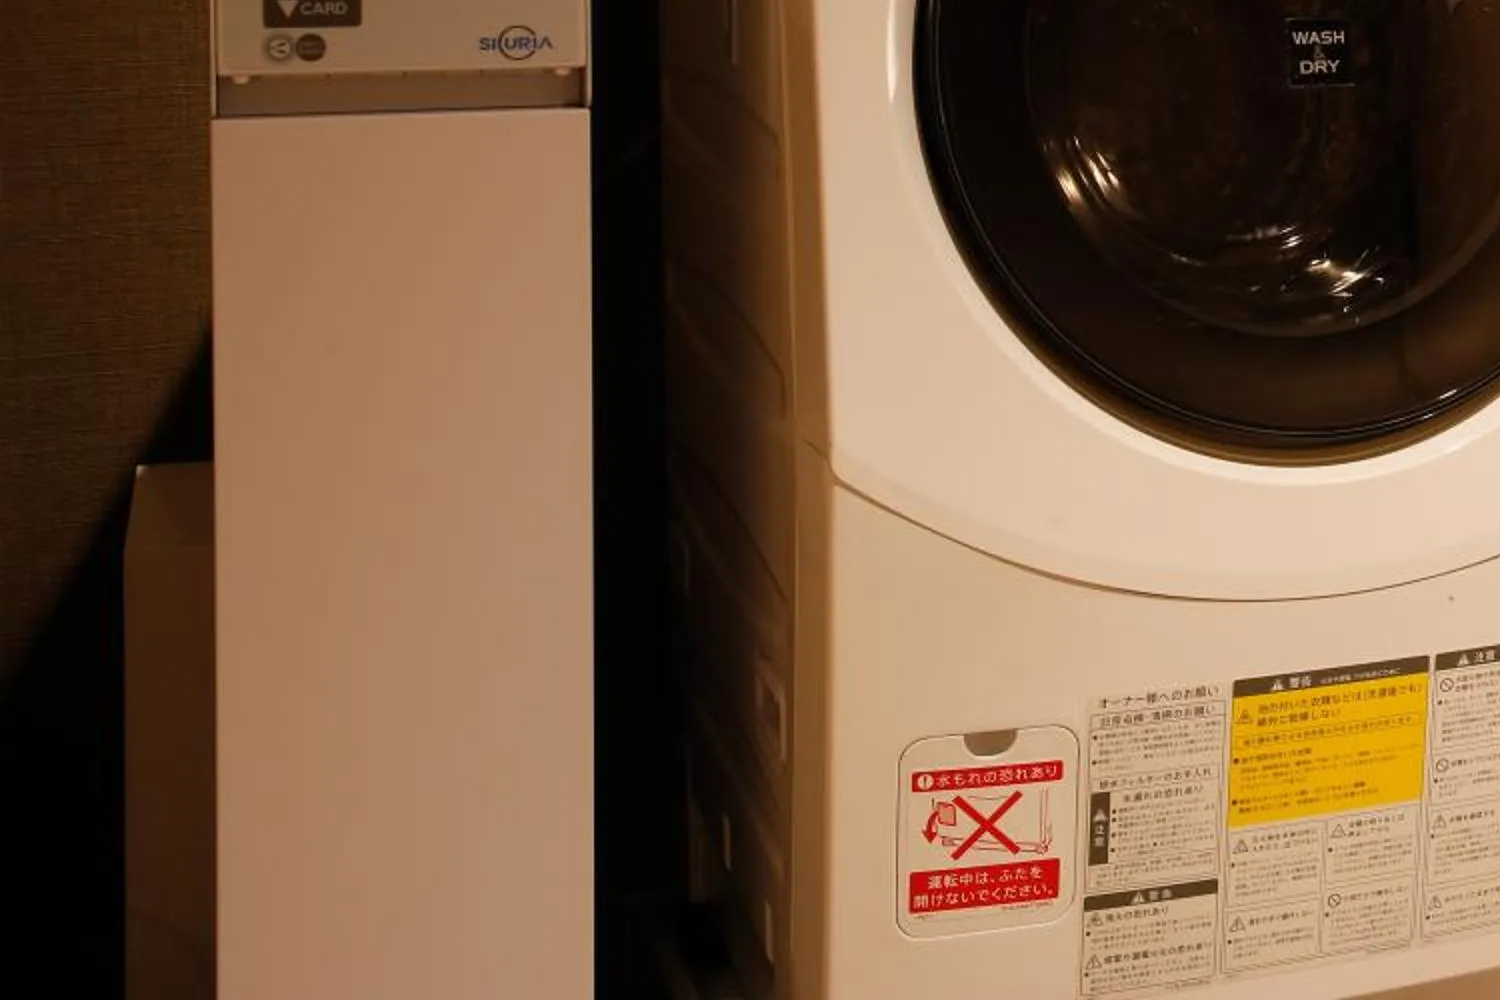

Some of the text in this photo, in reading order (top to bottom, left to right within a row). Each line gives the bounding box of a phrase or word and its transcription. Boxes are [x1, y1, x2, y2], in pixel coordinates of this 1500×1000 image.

[300, 1, 349, 16] CARD
[1291, 30, 1345, 45] WASH
[1299, 60, 1341, 75] DRY
